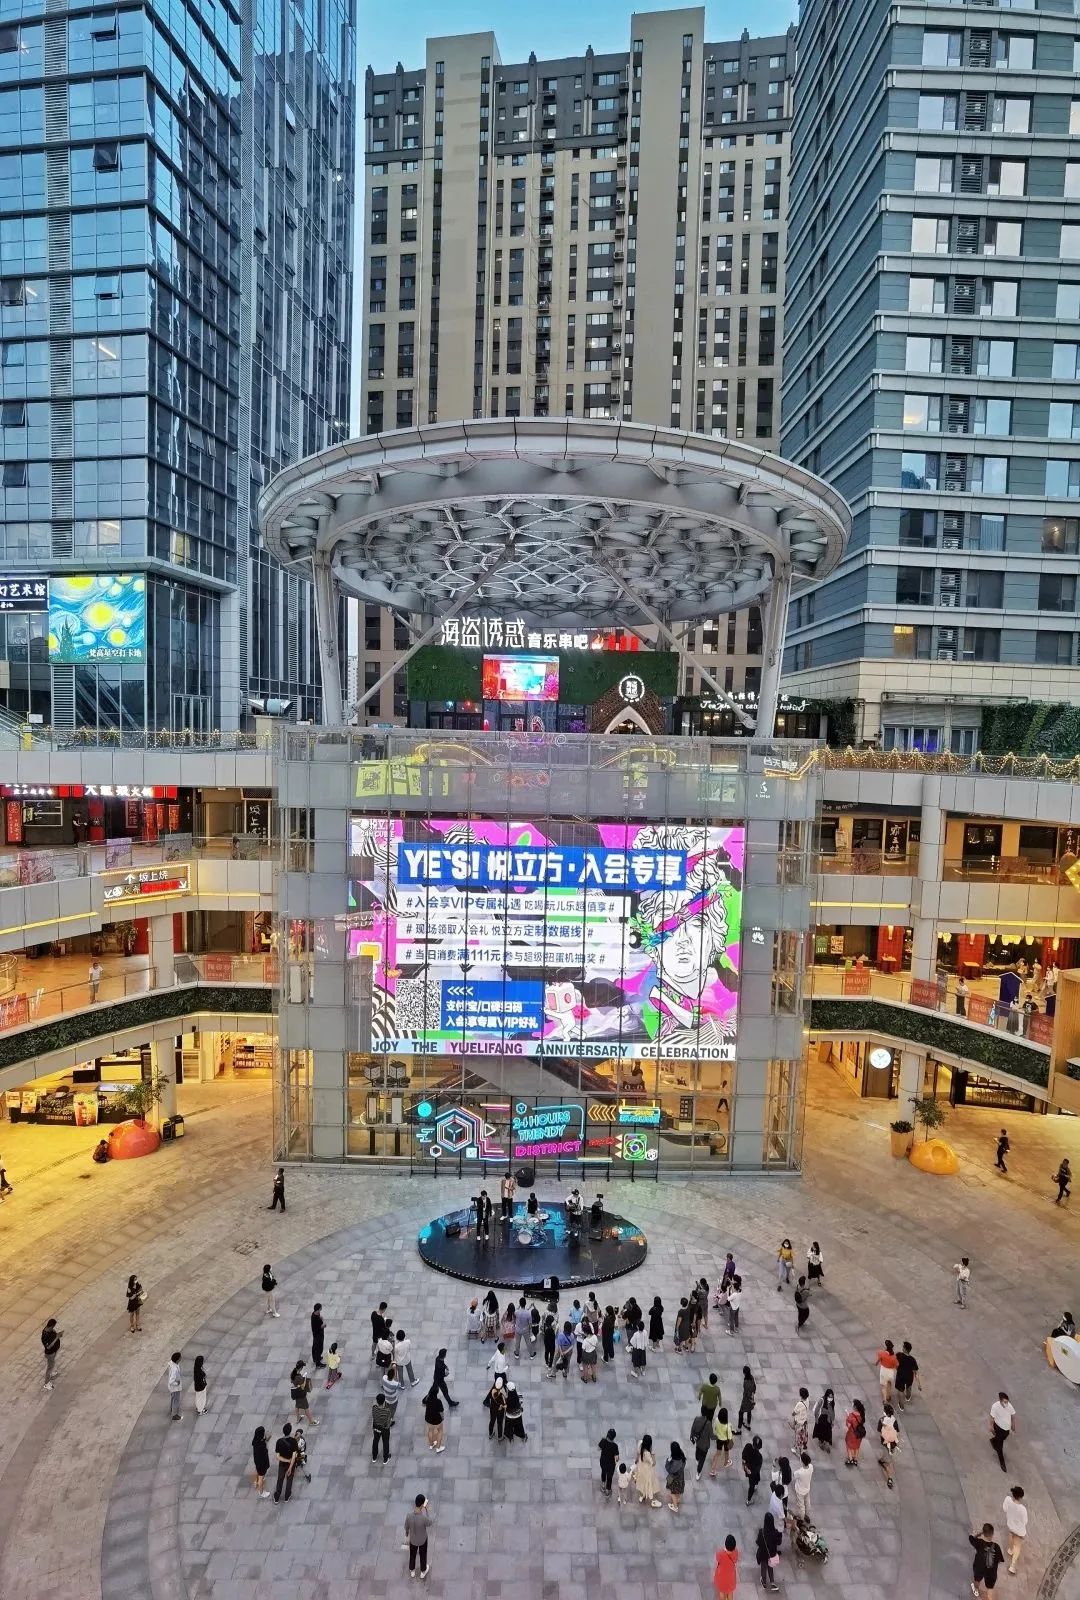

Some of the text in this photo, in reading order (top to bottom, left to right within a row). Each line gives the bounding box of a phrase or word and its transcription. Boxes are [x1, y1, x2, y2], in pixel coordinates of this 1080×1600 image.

[441, 616, 589, 649] 海盗诱惑 音乐串吧
[372, 1041, 729, 1059] JOY THE YUELIFANG ANNIVERSARY CELEBRATION
[517, 1124, 567, 1141] TRENDY
[515, 1141, 582, 1157] DISTRICT
